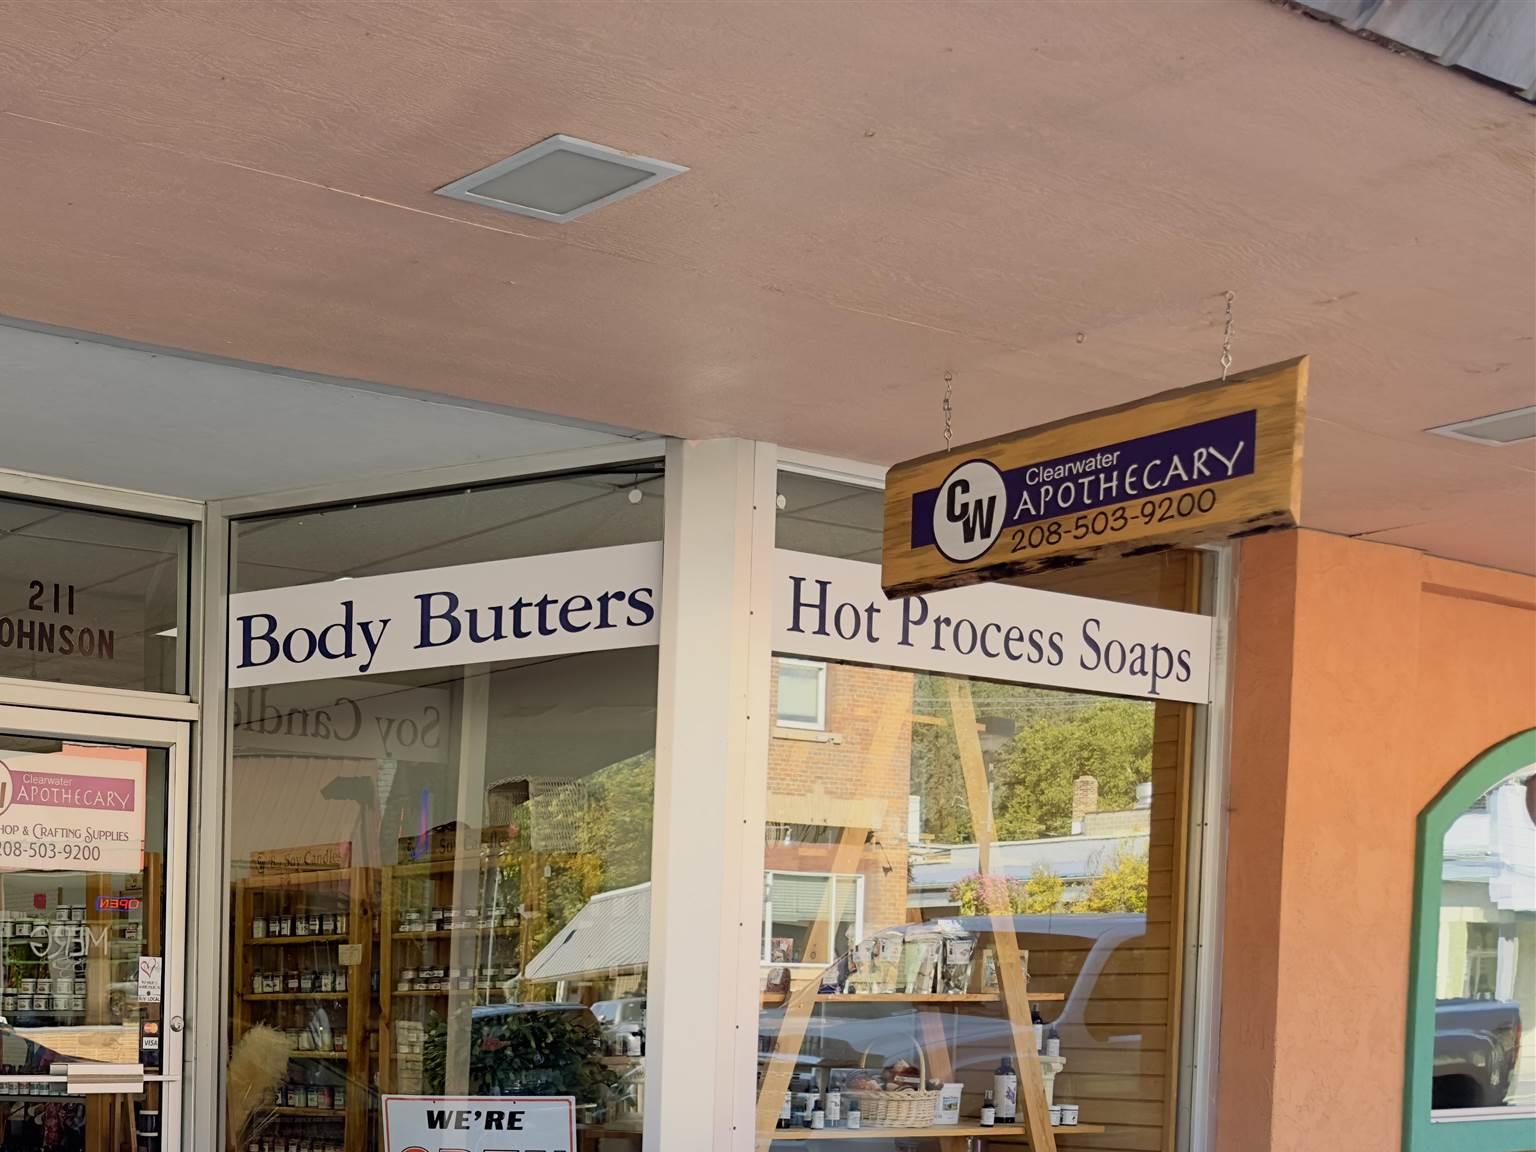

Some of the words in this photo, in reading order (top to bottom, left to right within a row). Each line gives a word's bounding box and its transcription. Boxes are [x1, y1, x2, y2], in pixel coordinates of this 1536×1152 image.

[1013, 440, 1245, 521] APOTHECARY
[1025, 448, 1121, 486] Clearwater
[1011, 488, 1217, 553] 208-503-9200
[28, 579, 75, 615] 211
[236, 600, 391, 673] Body
[413, 587, 655, 649] Butters
[786, 575, 881, 644] Hot
[897, 595, 1064, 668] Process
[1080, 617, 1192, 695] Soaps
[17, 785, 130, 809] APOTHECARY
[23, 773, 72, 787] Clearwater
[426, 1110, 525, 1130] WE'RE
